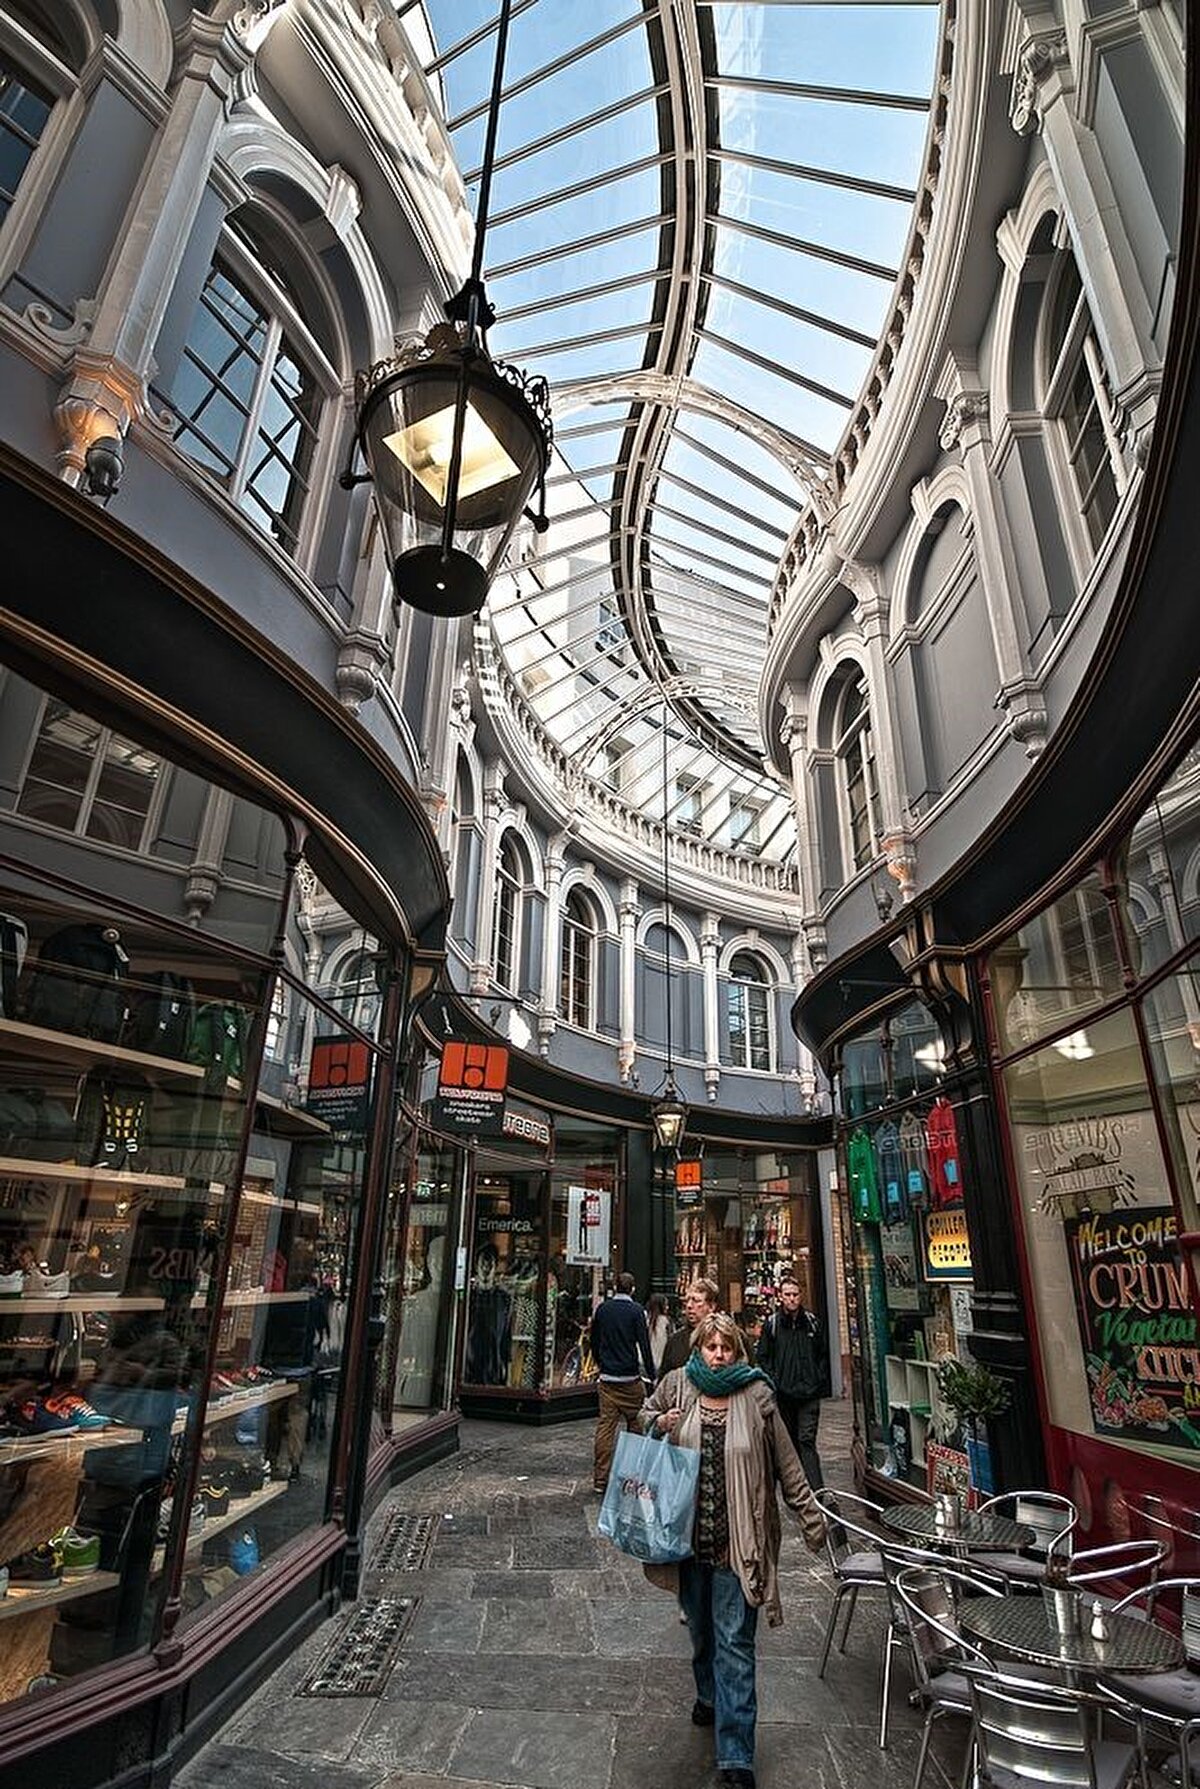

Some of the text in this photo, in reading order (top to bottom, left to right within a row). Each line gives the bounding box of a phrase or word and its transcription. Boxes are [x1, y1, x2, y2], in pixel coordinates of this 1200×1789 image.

[478, 1217, 534, 1232] Emerica.
[1078, 1215, 1177, 1259] WELCOME
[1123, 1249, 1147, 1269] TO
